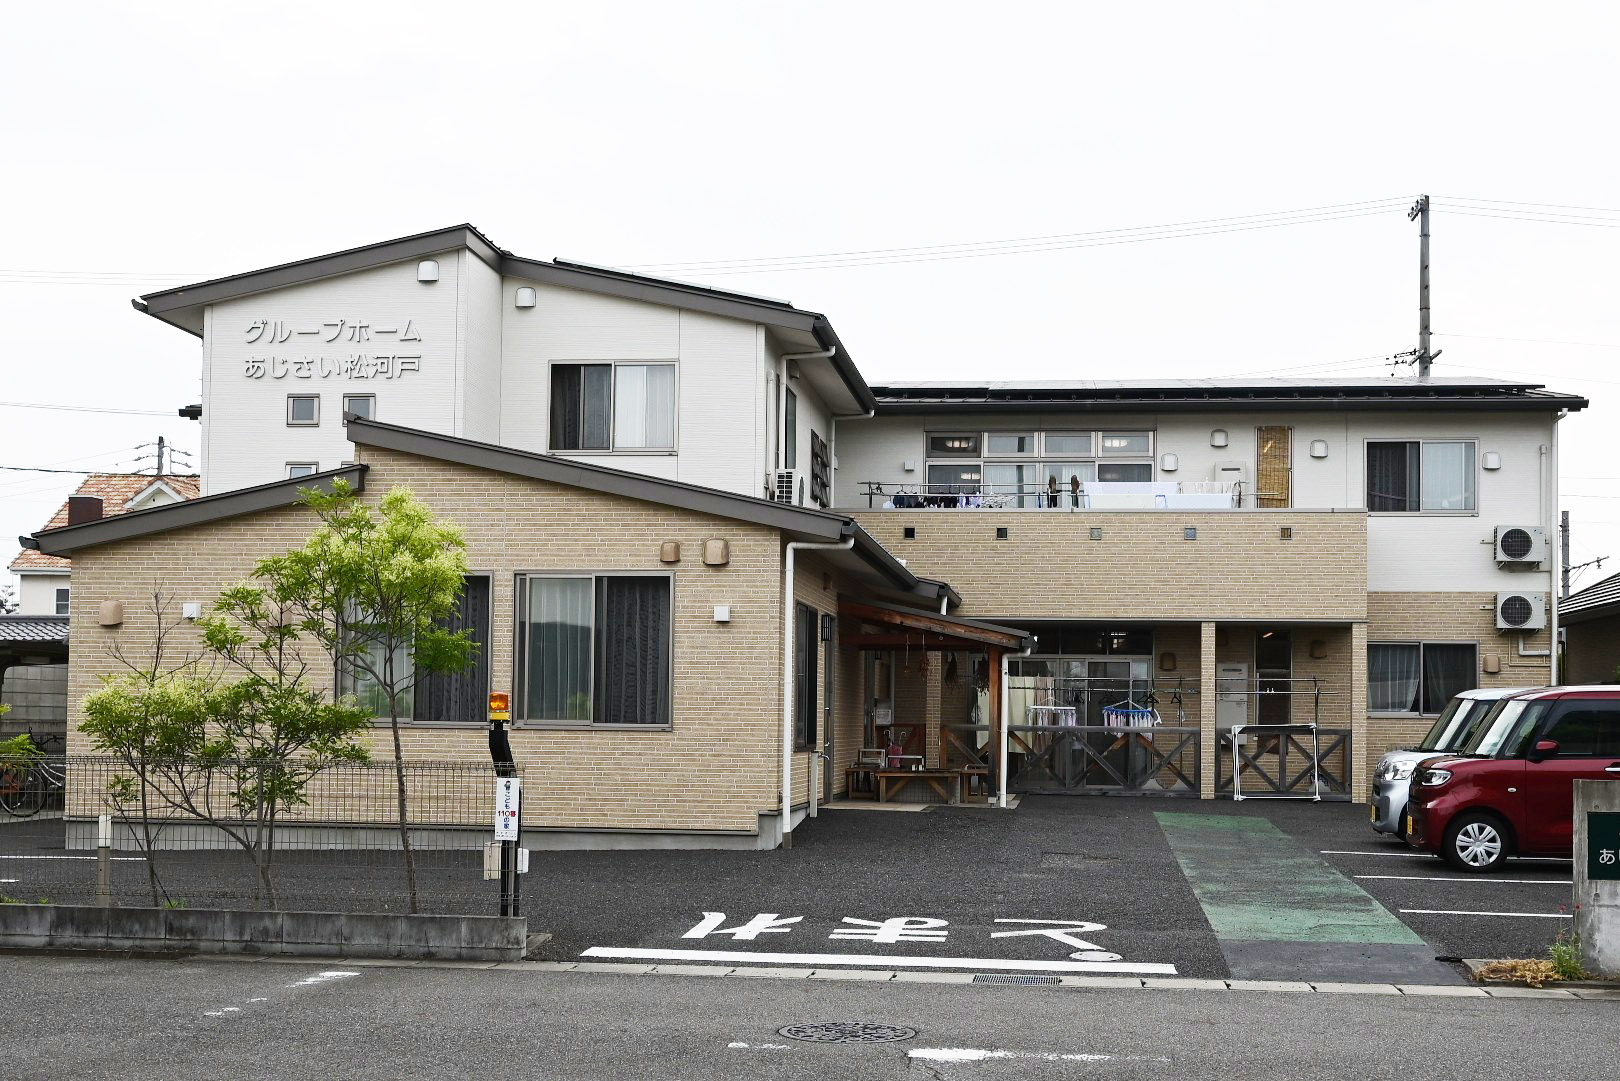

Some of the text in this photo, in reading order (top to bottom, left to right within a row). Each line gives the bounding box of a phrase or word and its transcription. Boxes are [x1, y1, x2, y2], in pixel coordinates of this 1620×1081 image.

[246, 319, 422, 344] グループホーム
[245, 353, 422, 379] あじさい松河戸
[1599, 848, 1620, 865] あ
